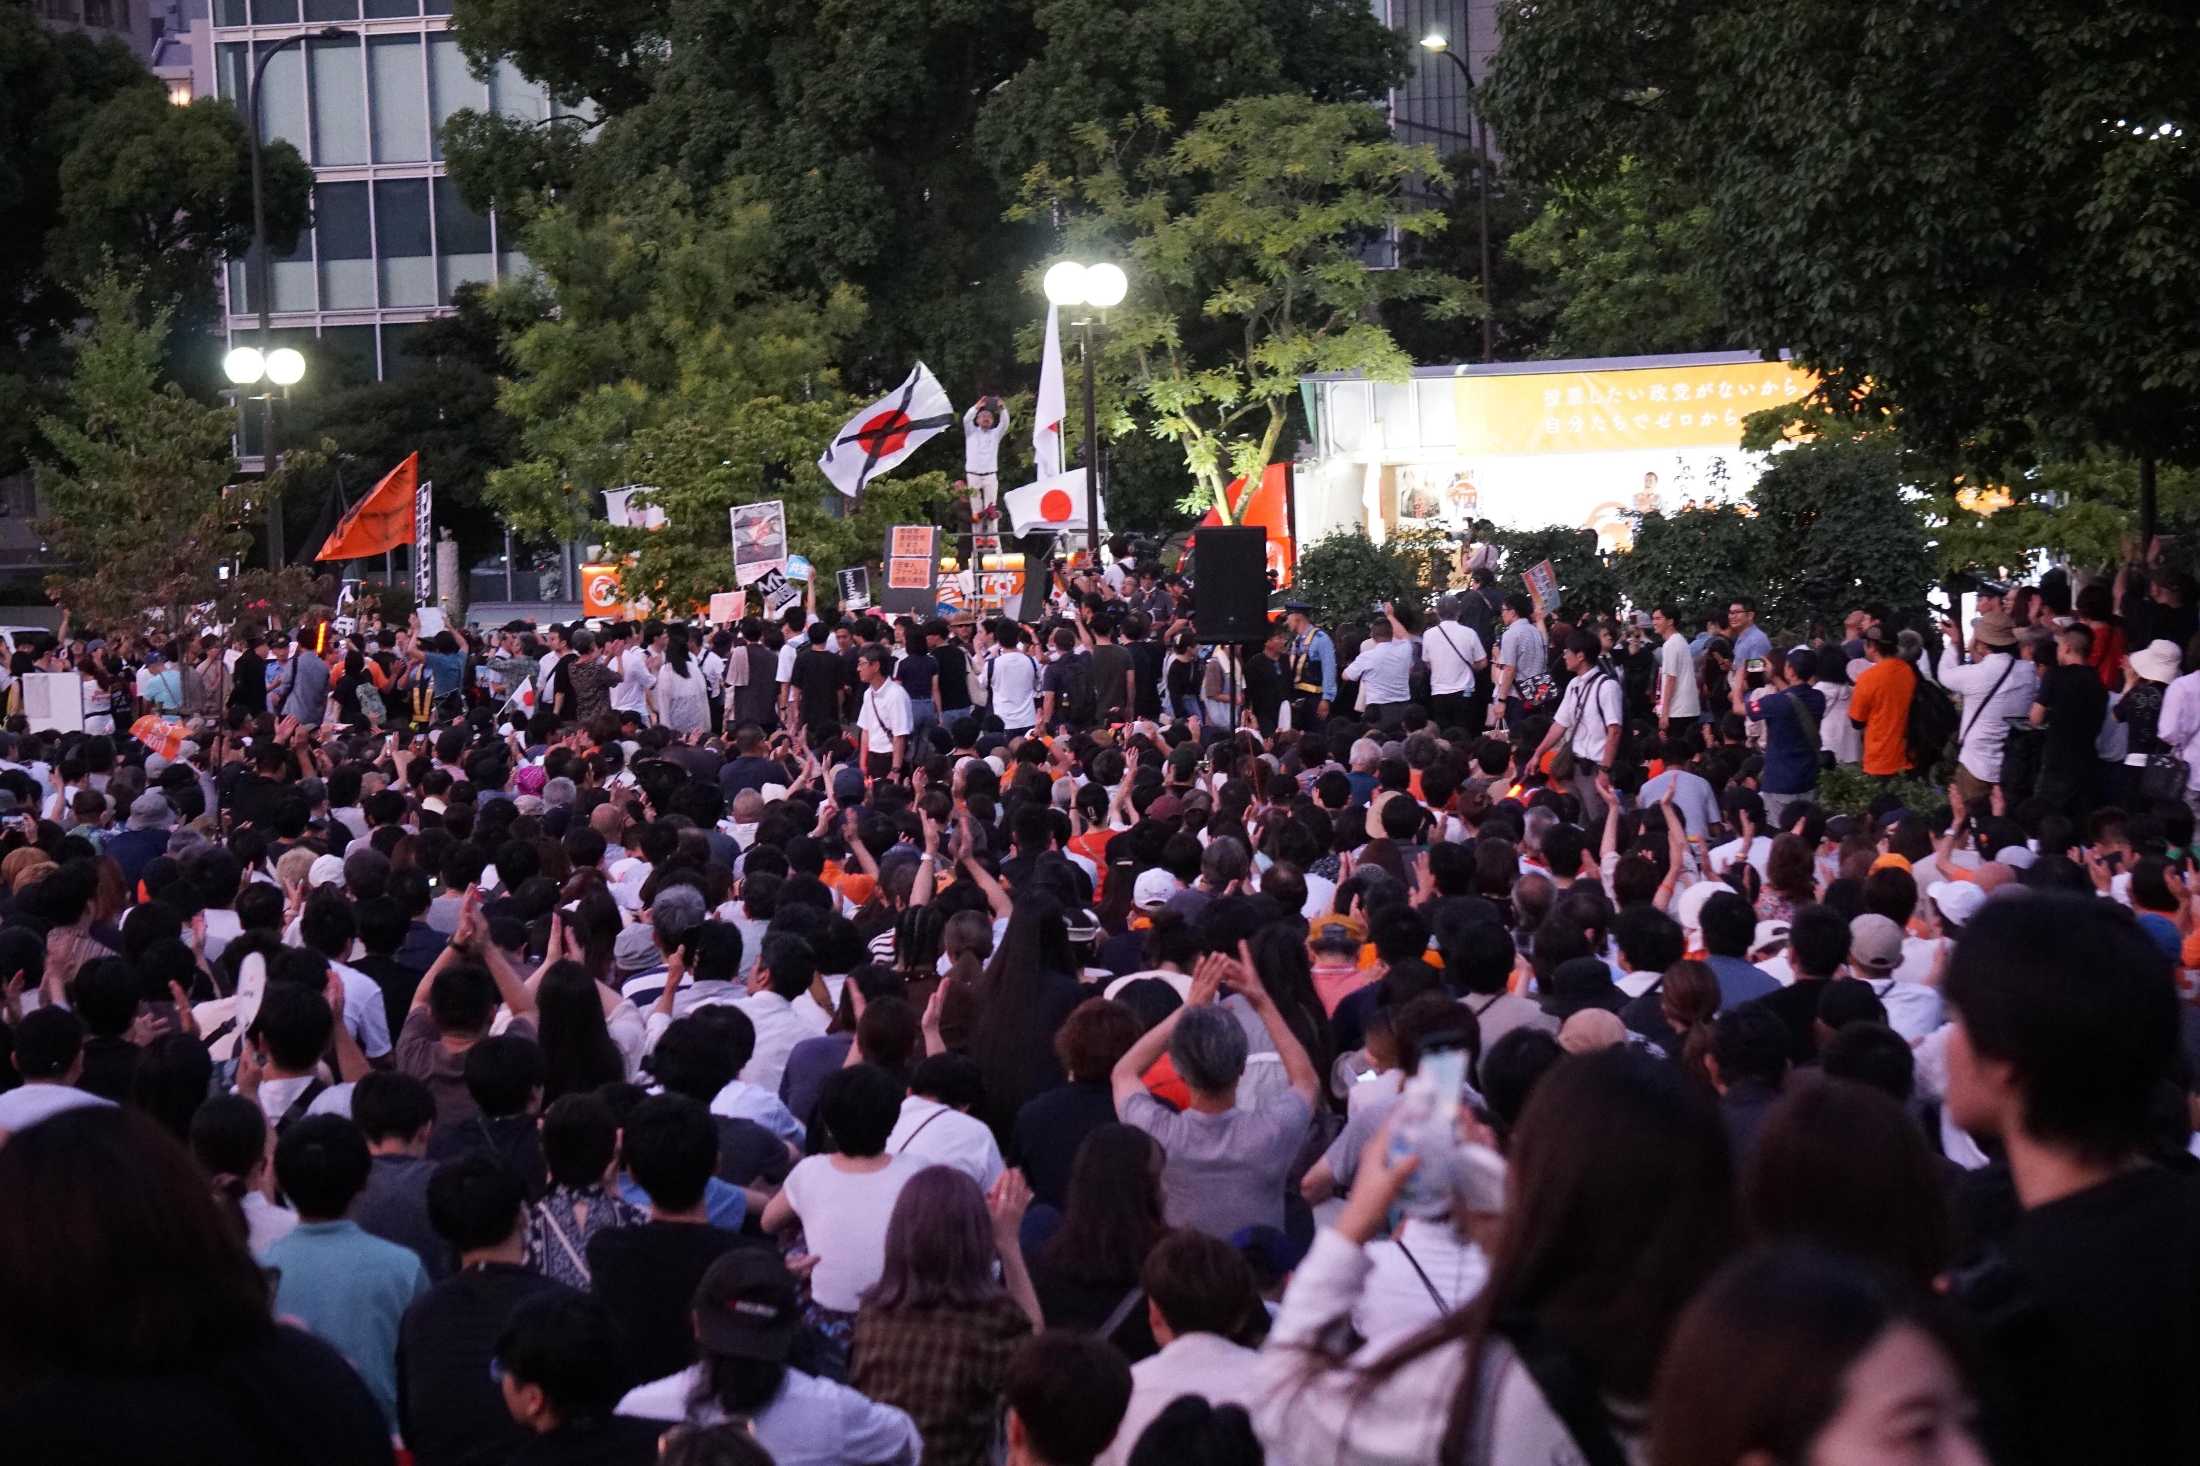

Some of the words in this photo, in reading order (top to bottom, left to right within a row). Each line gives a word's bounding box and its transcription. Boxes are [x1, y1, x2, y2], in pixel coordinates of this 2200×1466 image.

[1543, 377, 1809, 407] 投票したい政党がないから、
[1544, 408, 1740, 434] 自分たちでゼロから
